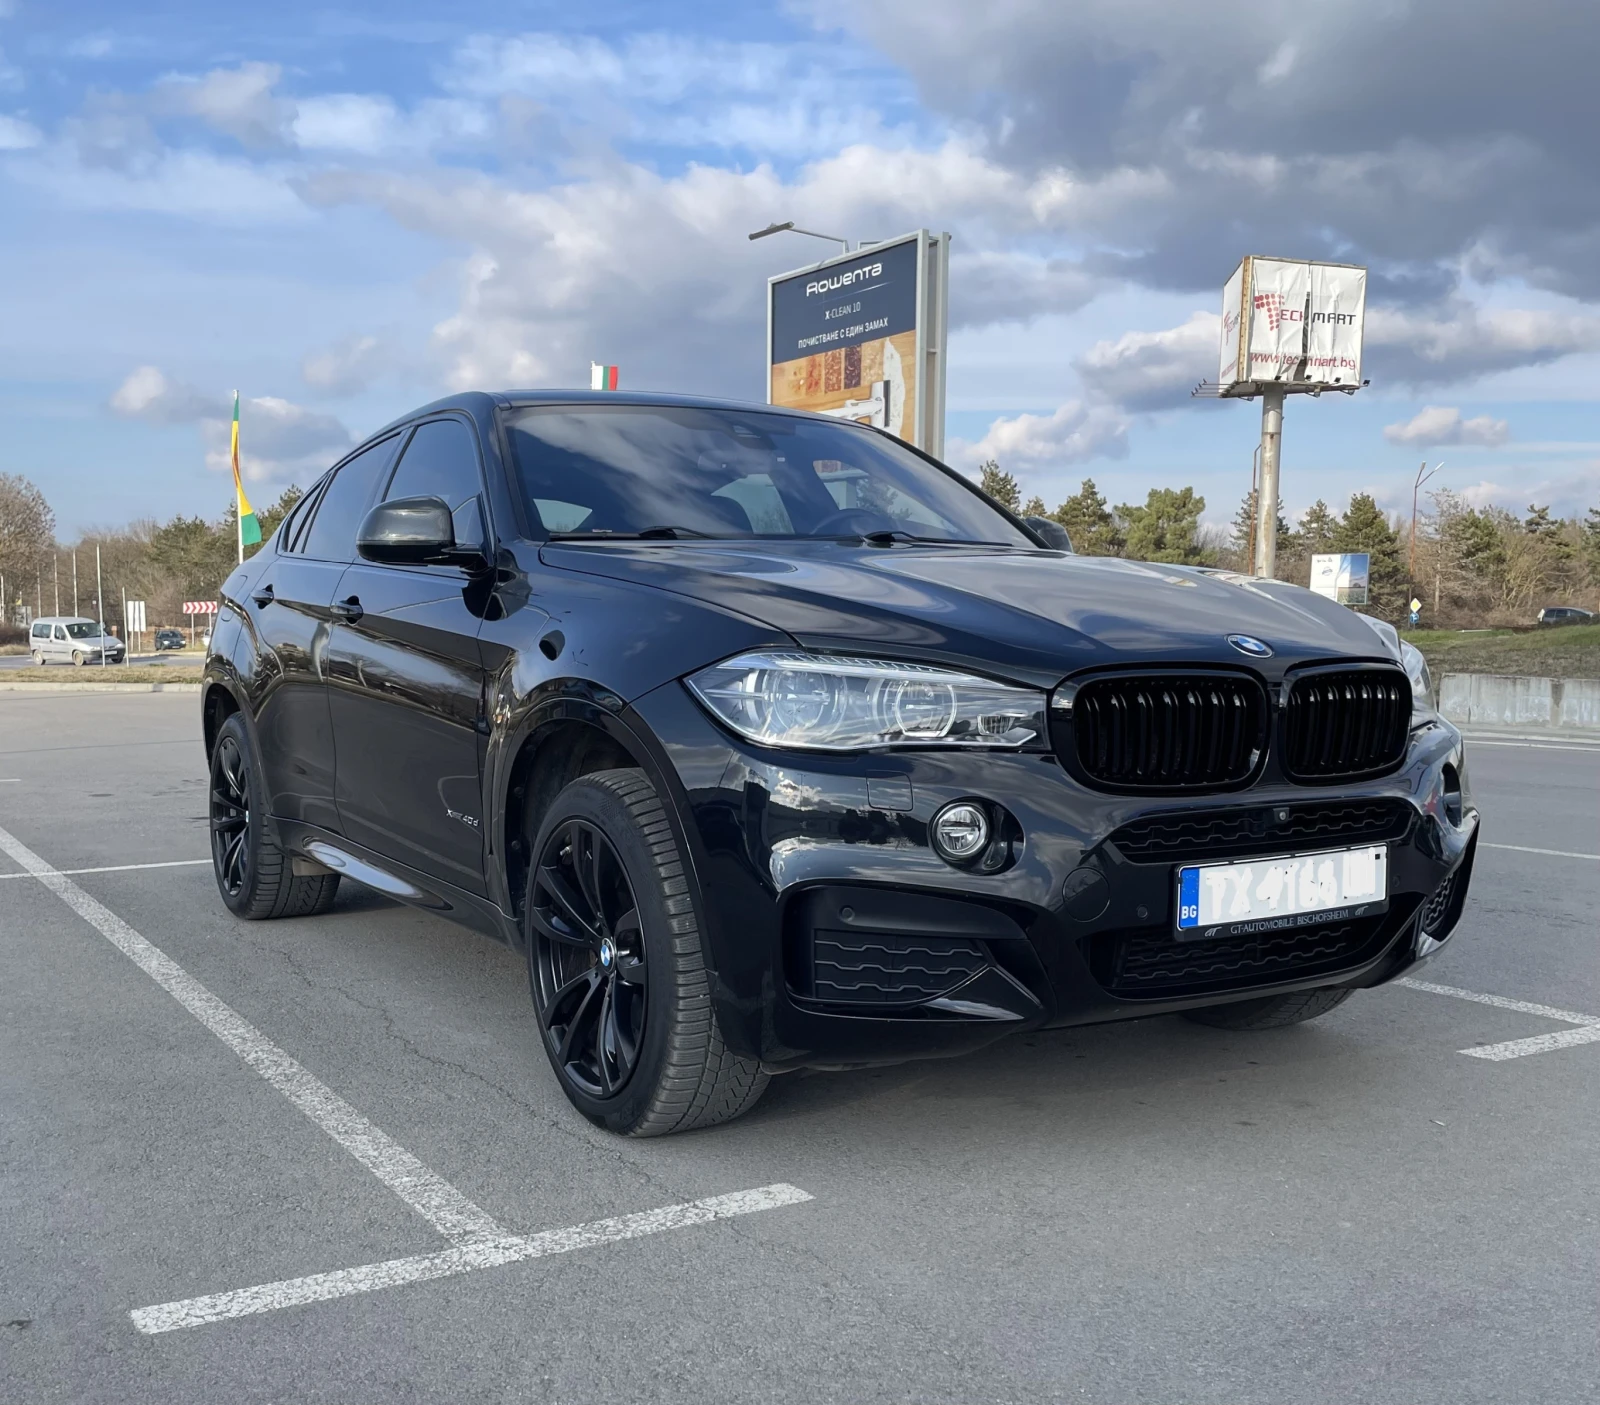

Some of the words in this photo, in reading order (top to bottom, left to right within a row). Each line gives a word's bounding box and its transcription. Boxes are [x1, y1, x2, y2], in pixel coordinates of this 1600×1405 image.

[825, 304, 852, 320] X-CLEAN
[852, 301, 861, 313] 10
[798, 330, 839, 349] ПОЧИСТВАНЕ
[846, 324, 864, 338] ЕДИН
[865, 317, 889, 332] ЗАМАХ
[1181, 904, 1198, 919] BG
[1230, 917, 1294, 934] GT-AUTOMOBILE
[1297, 909, 1349, 925] BISCHOFSHEIM
